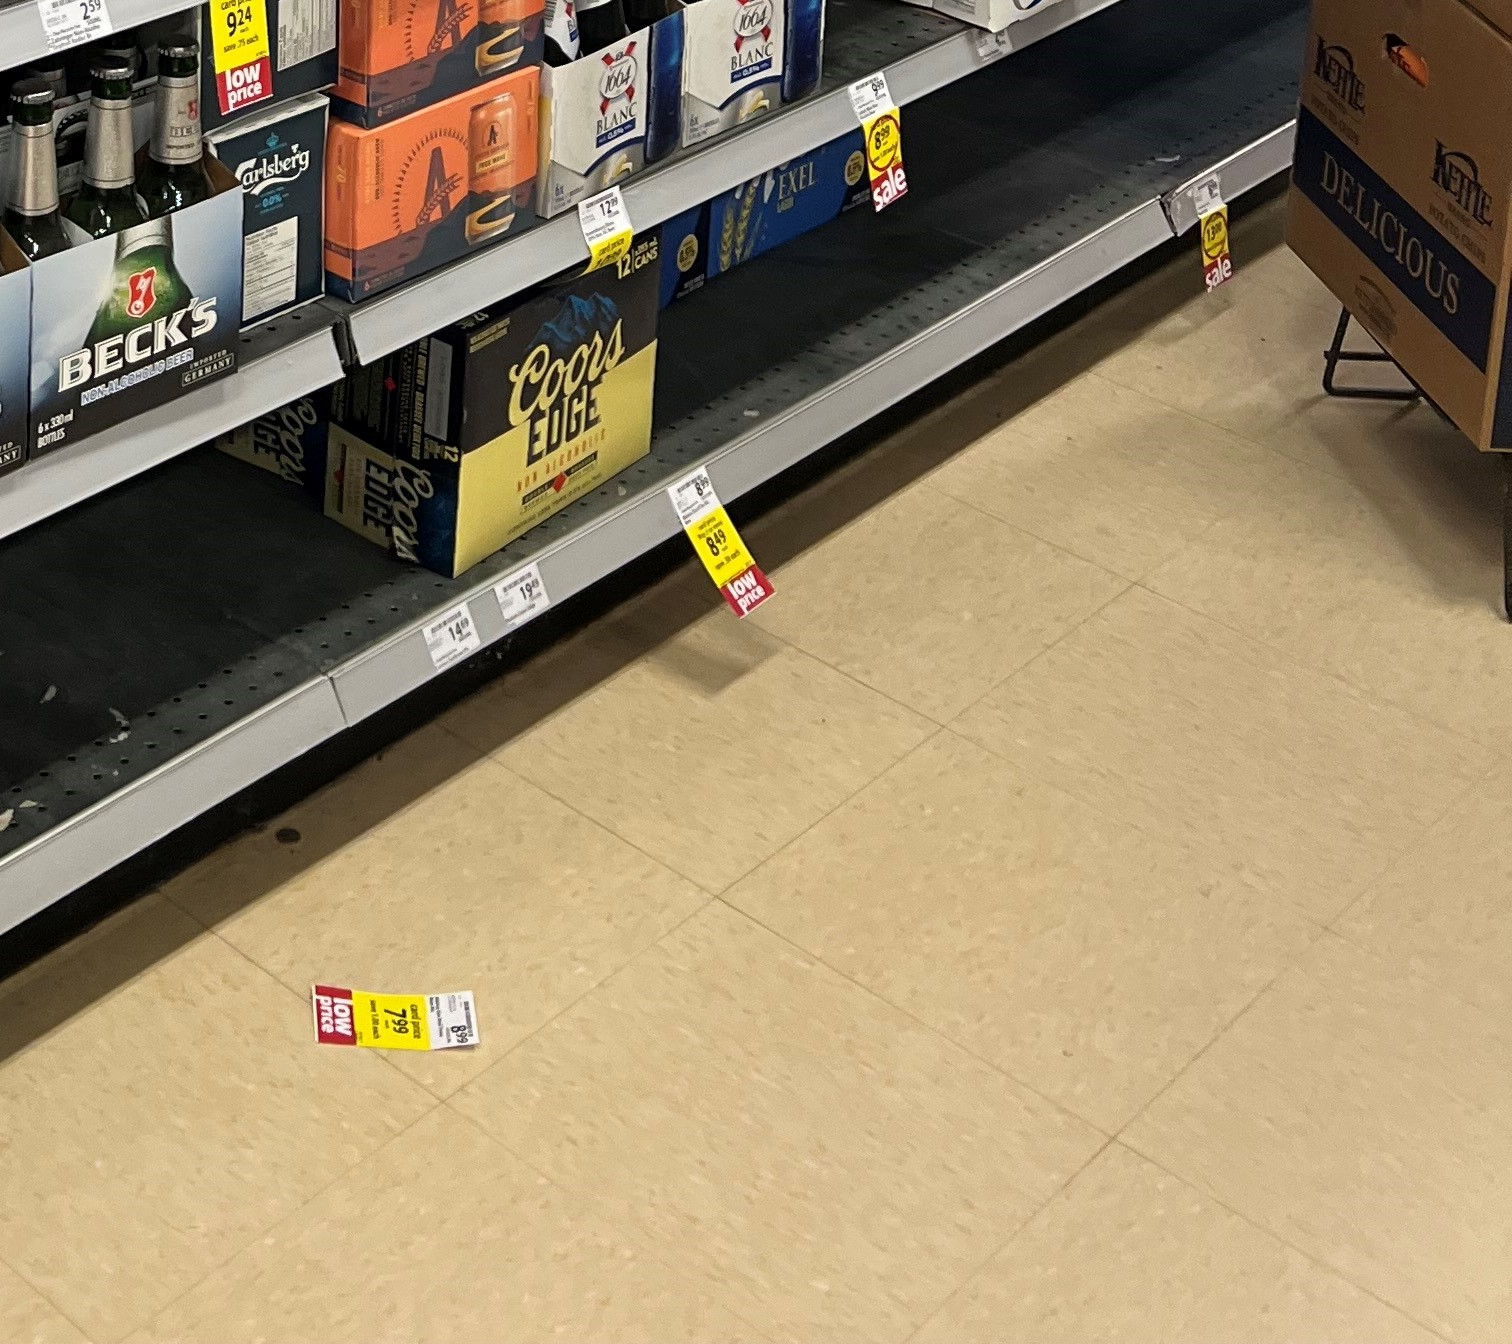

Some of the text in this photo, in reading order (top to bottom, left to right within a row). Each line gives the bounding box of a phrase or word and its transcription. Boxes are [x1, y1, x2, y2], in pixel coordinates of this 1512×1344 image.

[730, 44, 773, 75] BLANC
[595, 101, 638, 136] BLANC
[235, 144, 311, 194] Carlsberg
[777, 165, 819, 196] EXEL
[1320, 150, 1461, 315] DELICIOUS
[57, 296, 218, 393] BECK'S
[183, 356, 233, 384] GERMANY
[80, 347, 195, 407] NON-ALCOHOLIC BEER
[508, 319, 624, 427] Coors
[527, 381, 603, 465] EDGE
